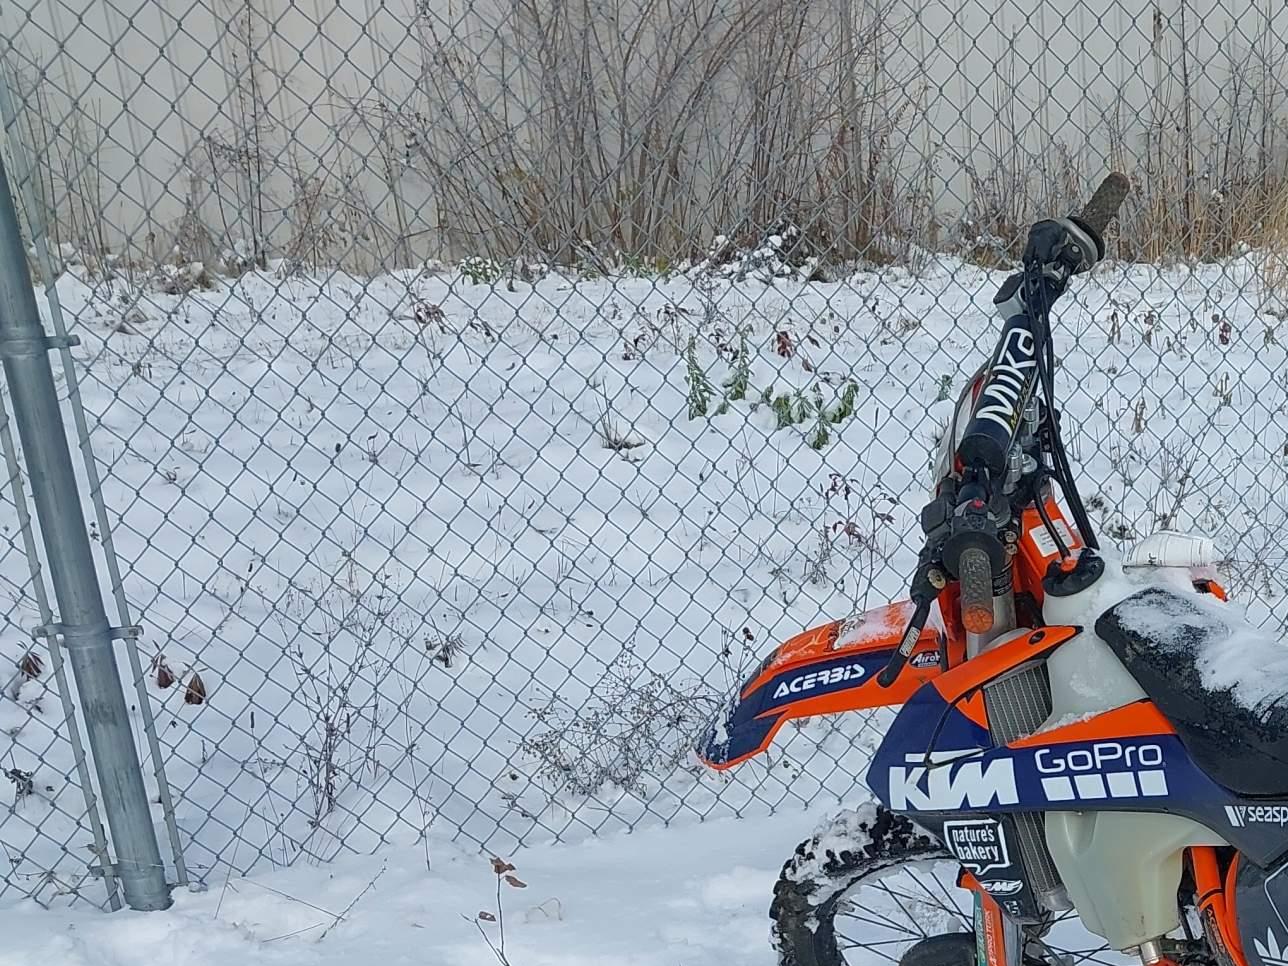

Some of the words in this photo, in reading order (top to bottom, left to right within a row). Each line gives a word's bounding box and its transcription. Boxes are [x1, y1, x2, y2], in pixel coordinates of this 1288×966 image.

[1034, 742, 1162, 774] GoPro
[889, 748, 1020, 811] KTM
[952, 824, 995, 844] nature's
[955, 843, 999, 862] bakery
